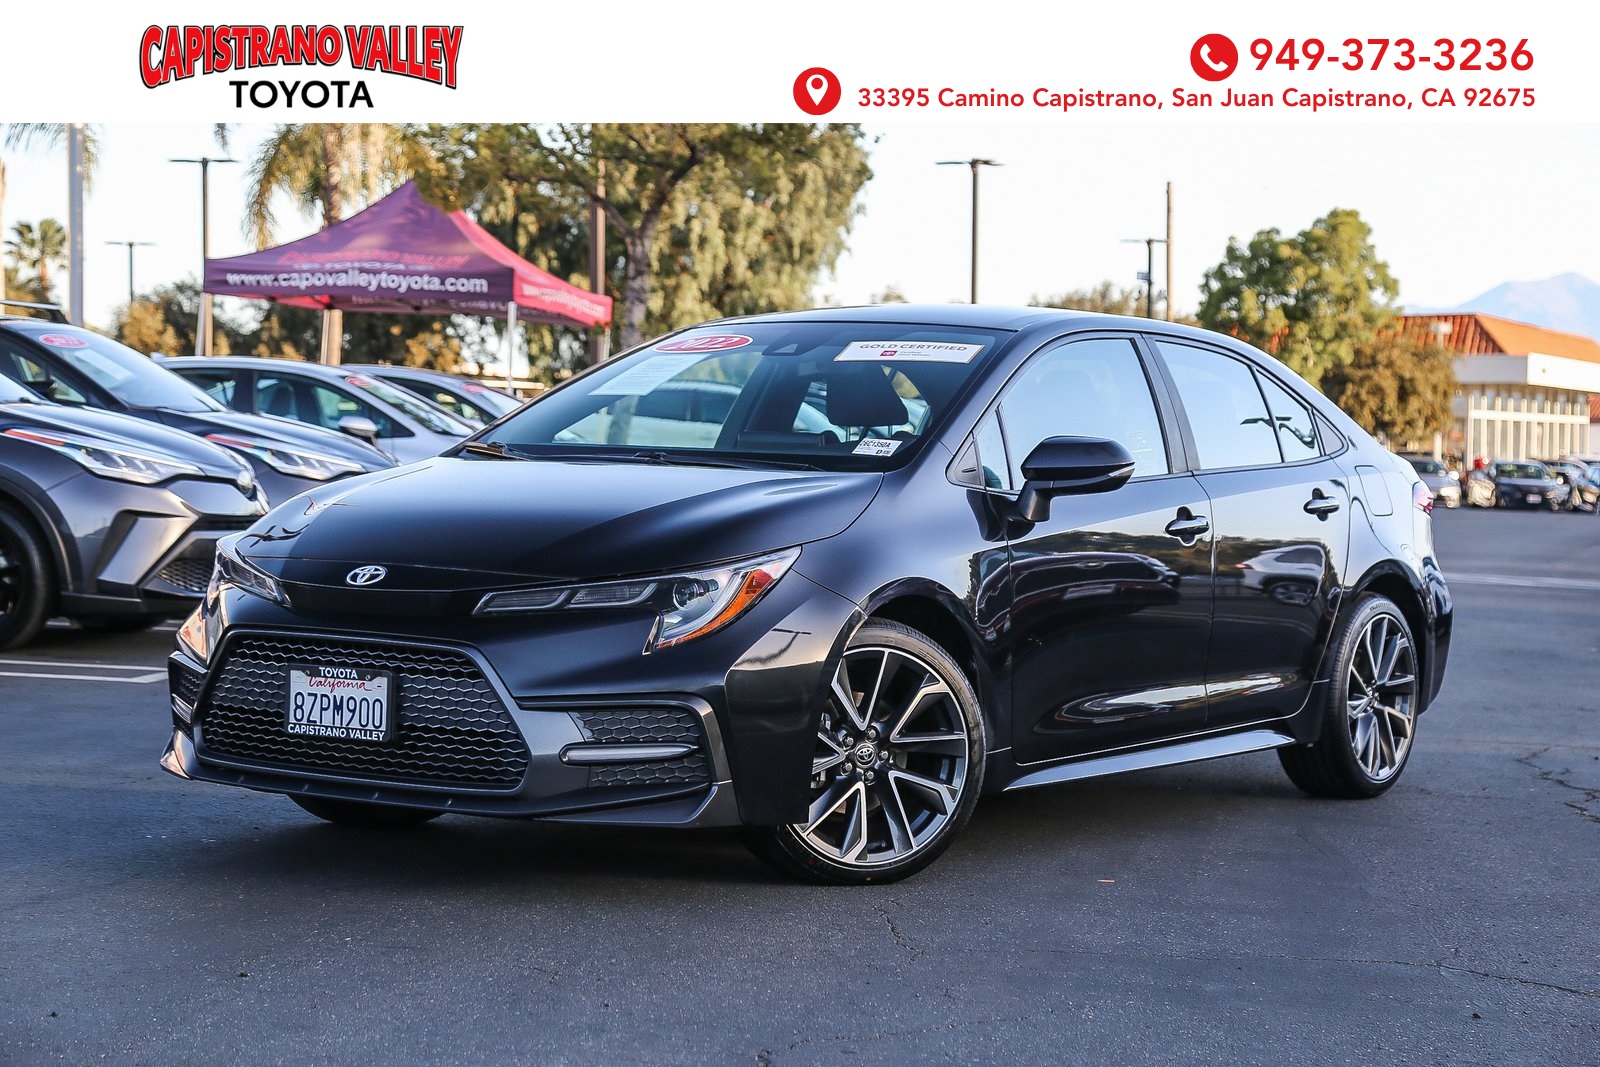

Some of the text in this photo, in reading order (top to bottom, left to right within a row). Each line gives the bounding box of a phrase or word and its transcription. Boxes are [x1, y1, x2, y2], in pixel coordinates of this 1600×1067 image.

[225, 268, 489, 293] www.capovalleytoyota.com
[319, 667, 358, 679] TOYOTA
[309, 676, 372, 693] California
[293, 691, 383, 729] 8ZPM900
[288, 724, 385, 741] CAPISTRANO VALLEY
